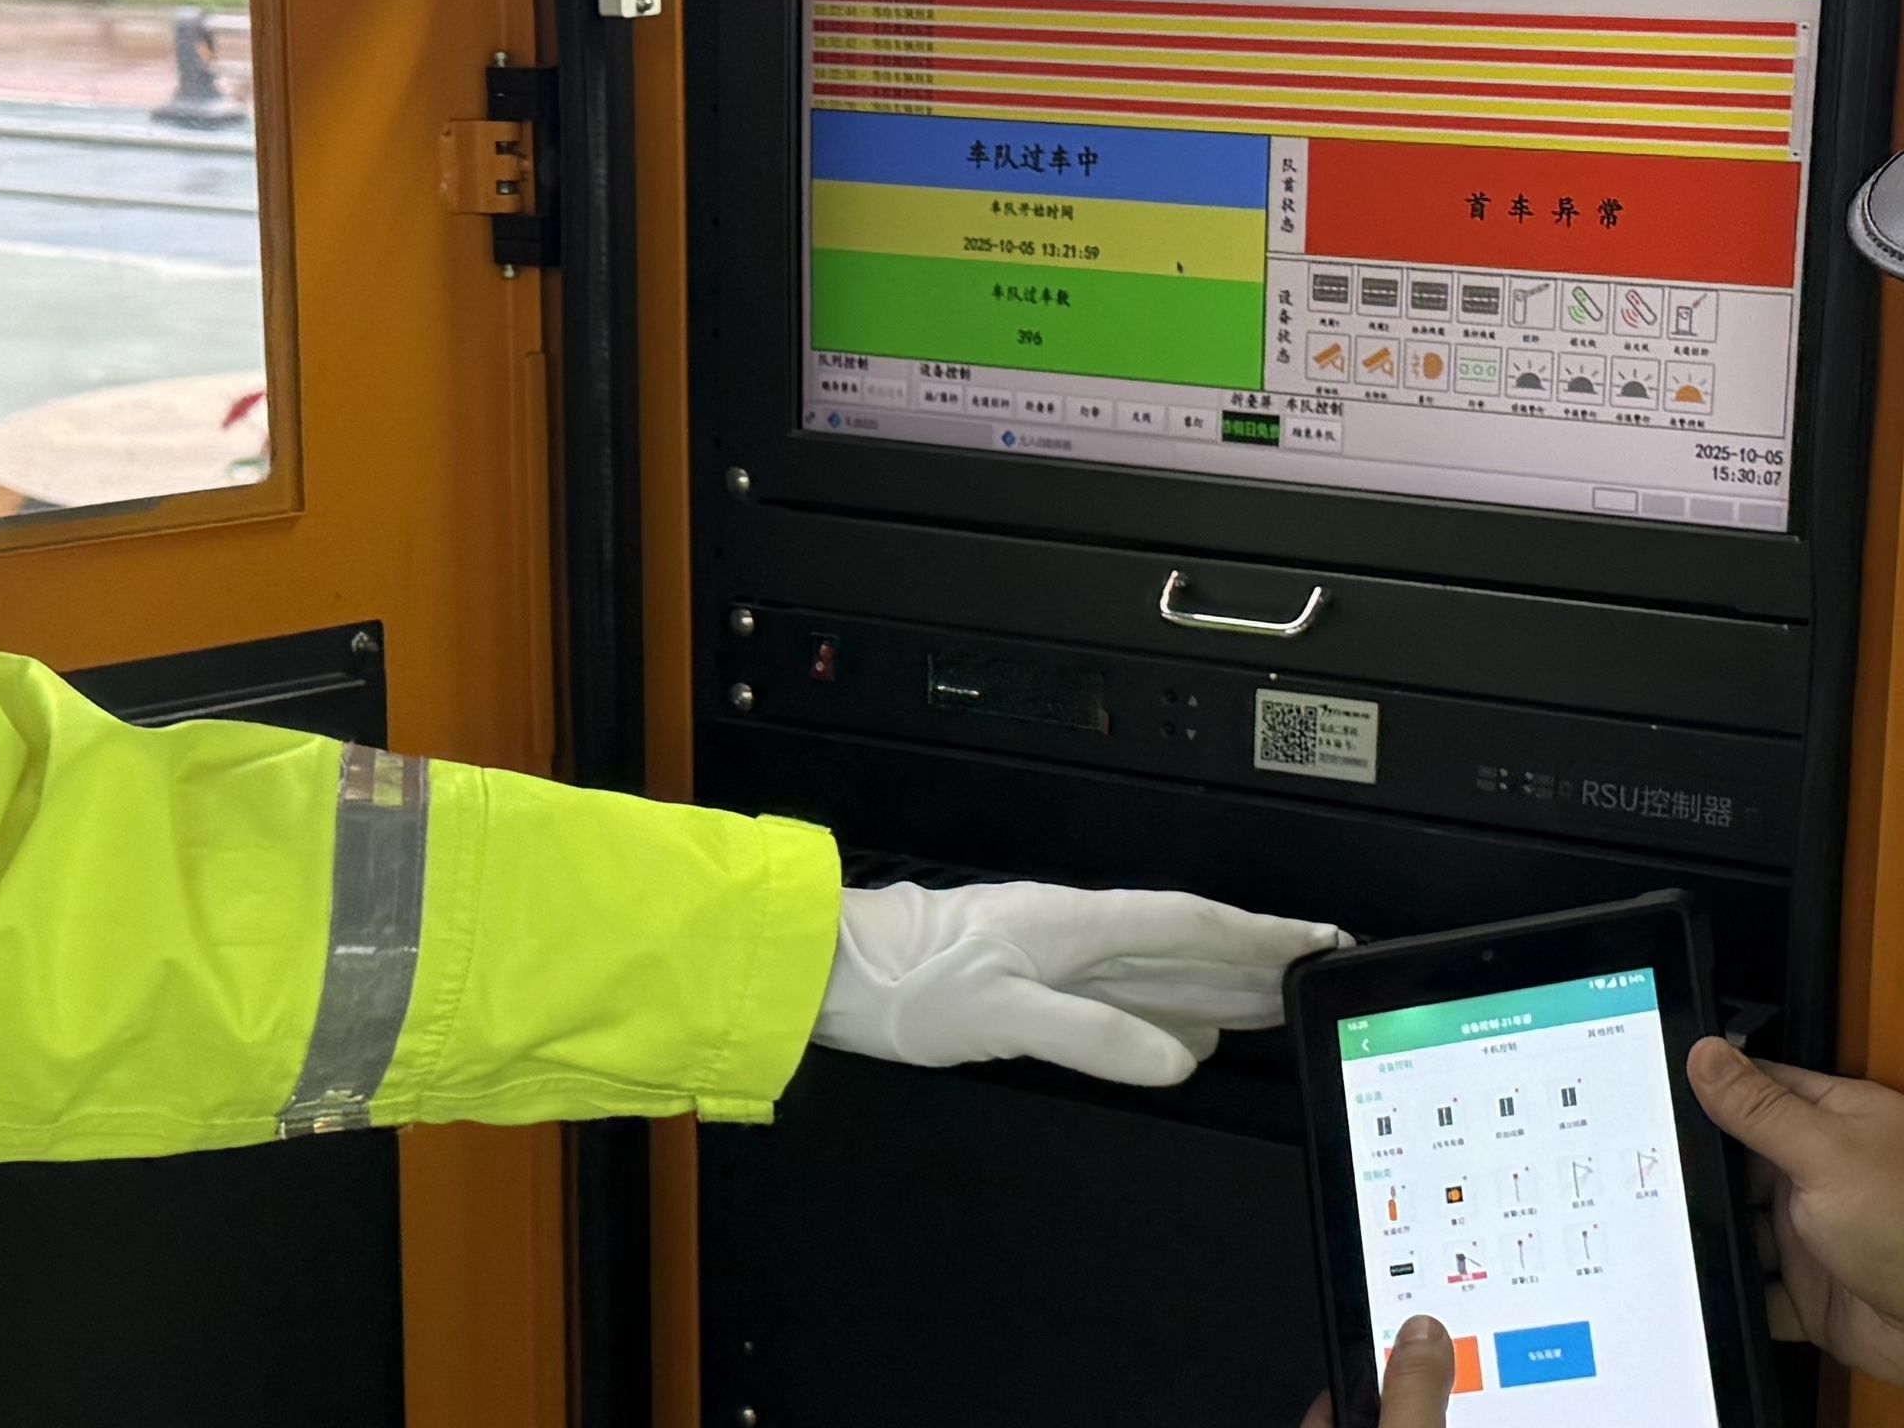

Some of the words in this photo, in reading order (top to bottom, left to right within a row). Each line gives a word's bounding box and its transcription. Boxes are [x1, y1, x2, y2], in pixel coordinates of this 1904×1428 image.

[966, 139, 1099, 177] 车队过车中
[989, 199, 1075, 222] 车队开始时间
[1464, 191, 1624, 230] 首车异常
[963, 236, 1035, 257] 2025-10-05
[1016, 329, 1043, 348] 396
[919, 363, 972, 381] 设备控制
[1285, 396, 1345, 417] 车队控制
[1694, 442, 1784, 465] 2025-10-05
[1711, 465, 1782, 487] 15:30:07
[1581, 779, 1734, 828] RSU控制器
